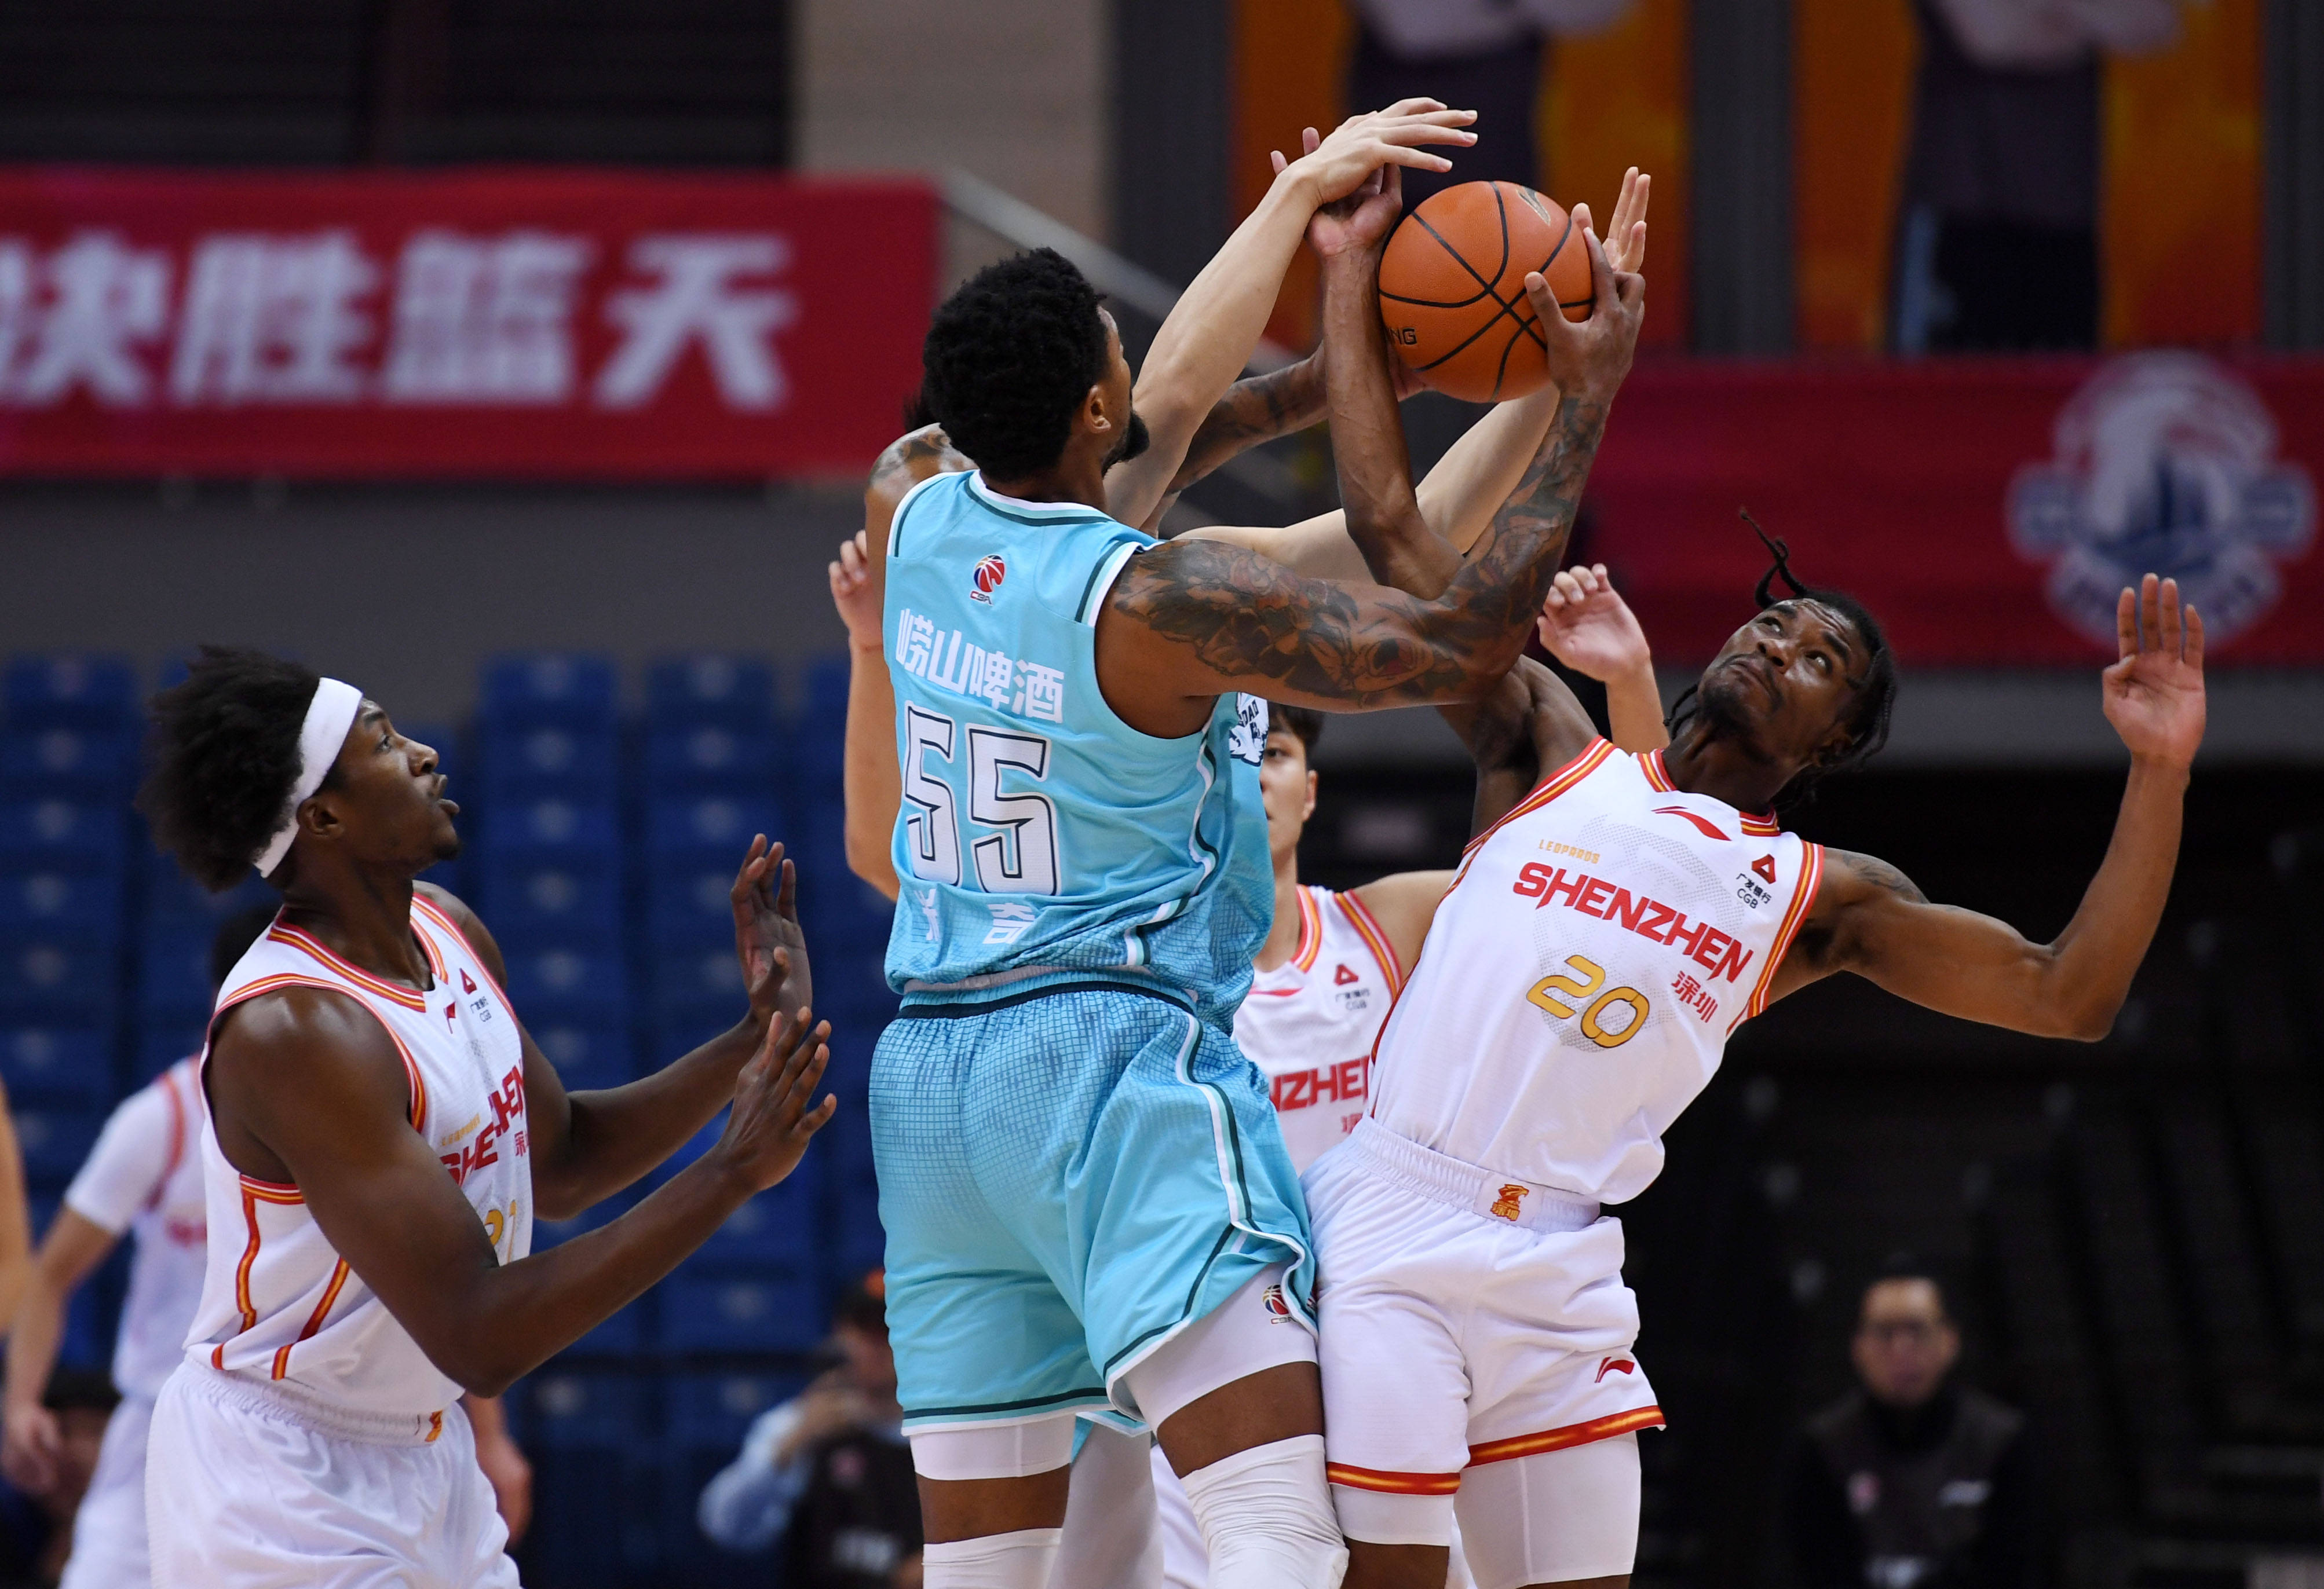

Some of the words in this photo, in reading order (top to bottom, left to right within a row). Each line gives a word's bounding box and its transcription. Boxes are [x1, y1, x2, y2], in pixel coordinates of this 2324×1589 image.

[896, 608, 1065, 724] 崂山啤酒
[904, 700, 1062, 896] 55
[1512, 862, 1754, 983] SHENZHEN
[1737, 888, 1759, 909] CGB
[1526, 954, 1650, 1049] 20
[1671, 970, 1719, 1023] 深圳
